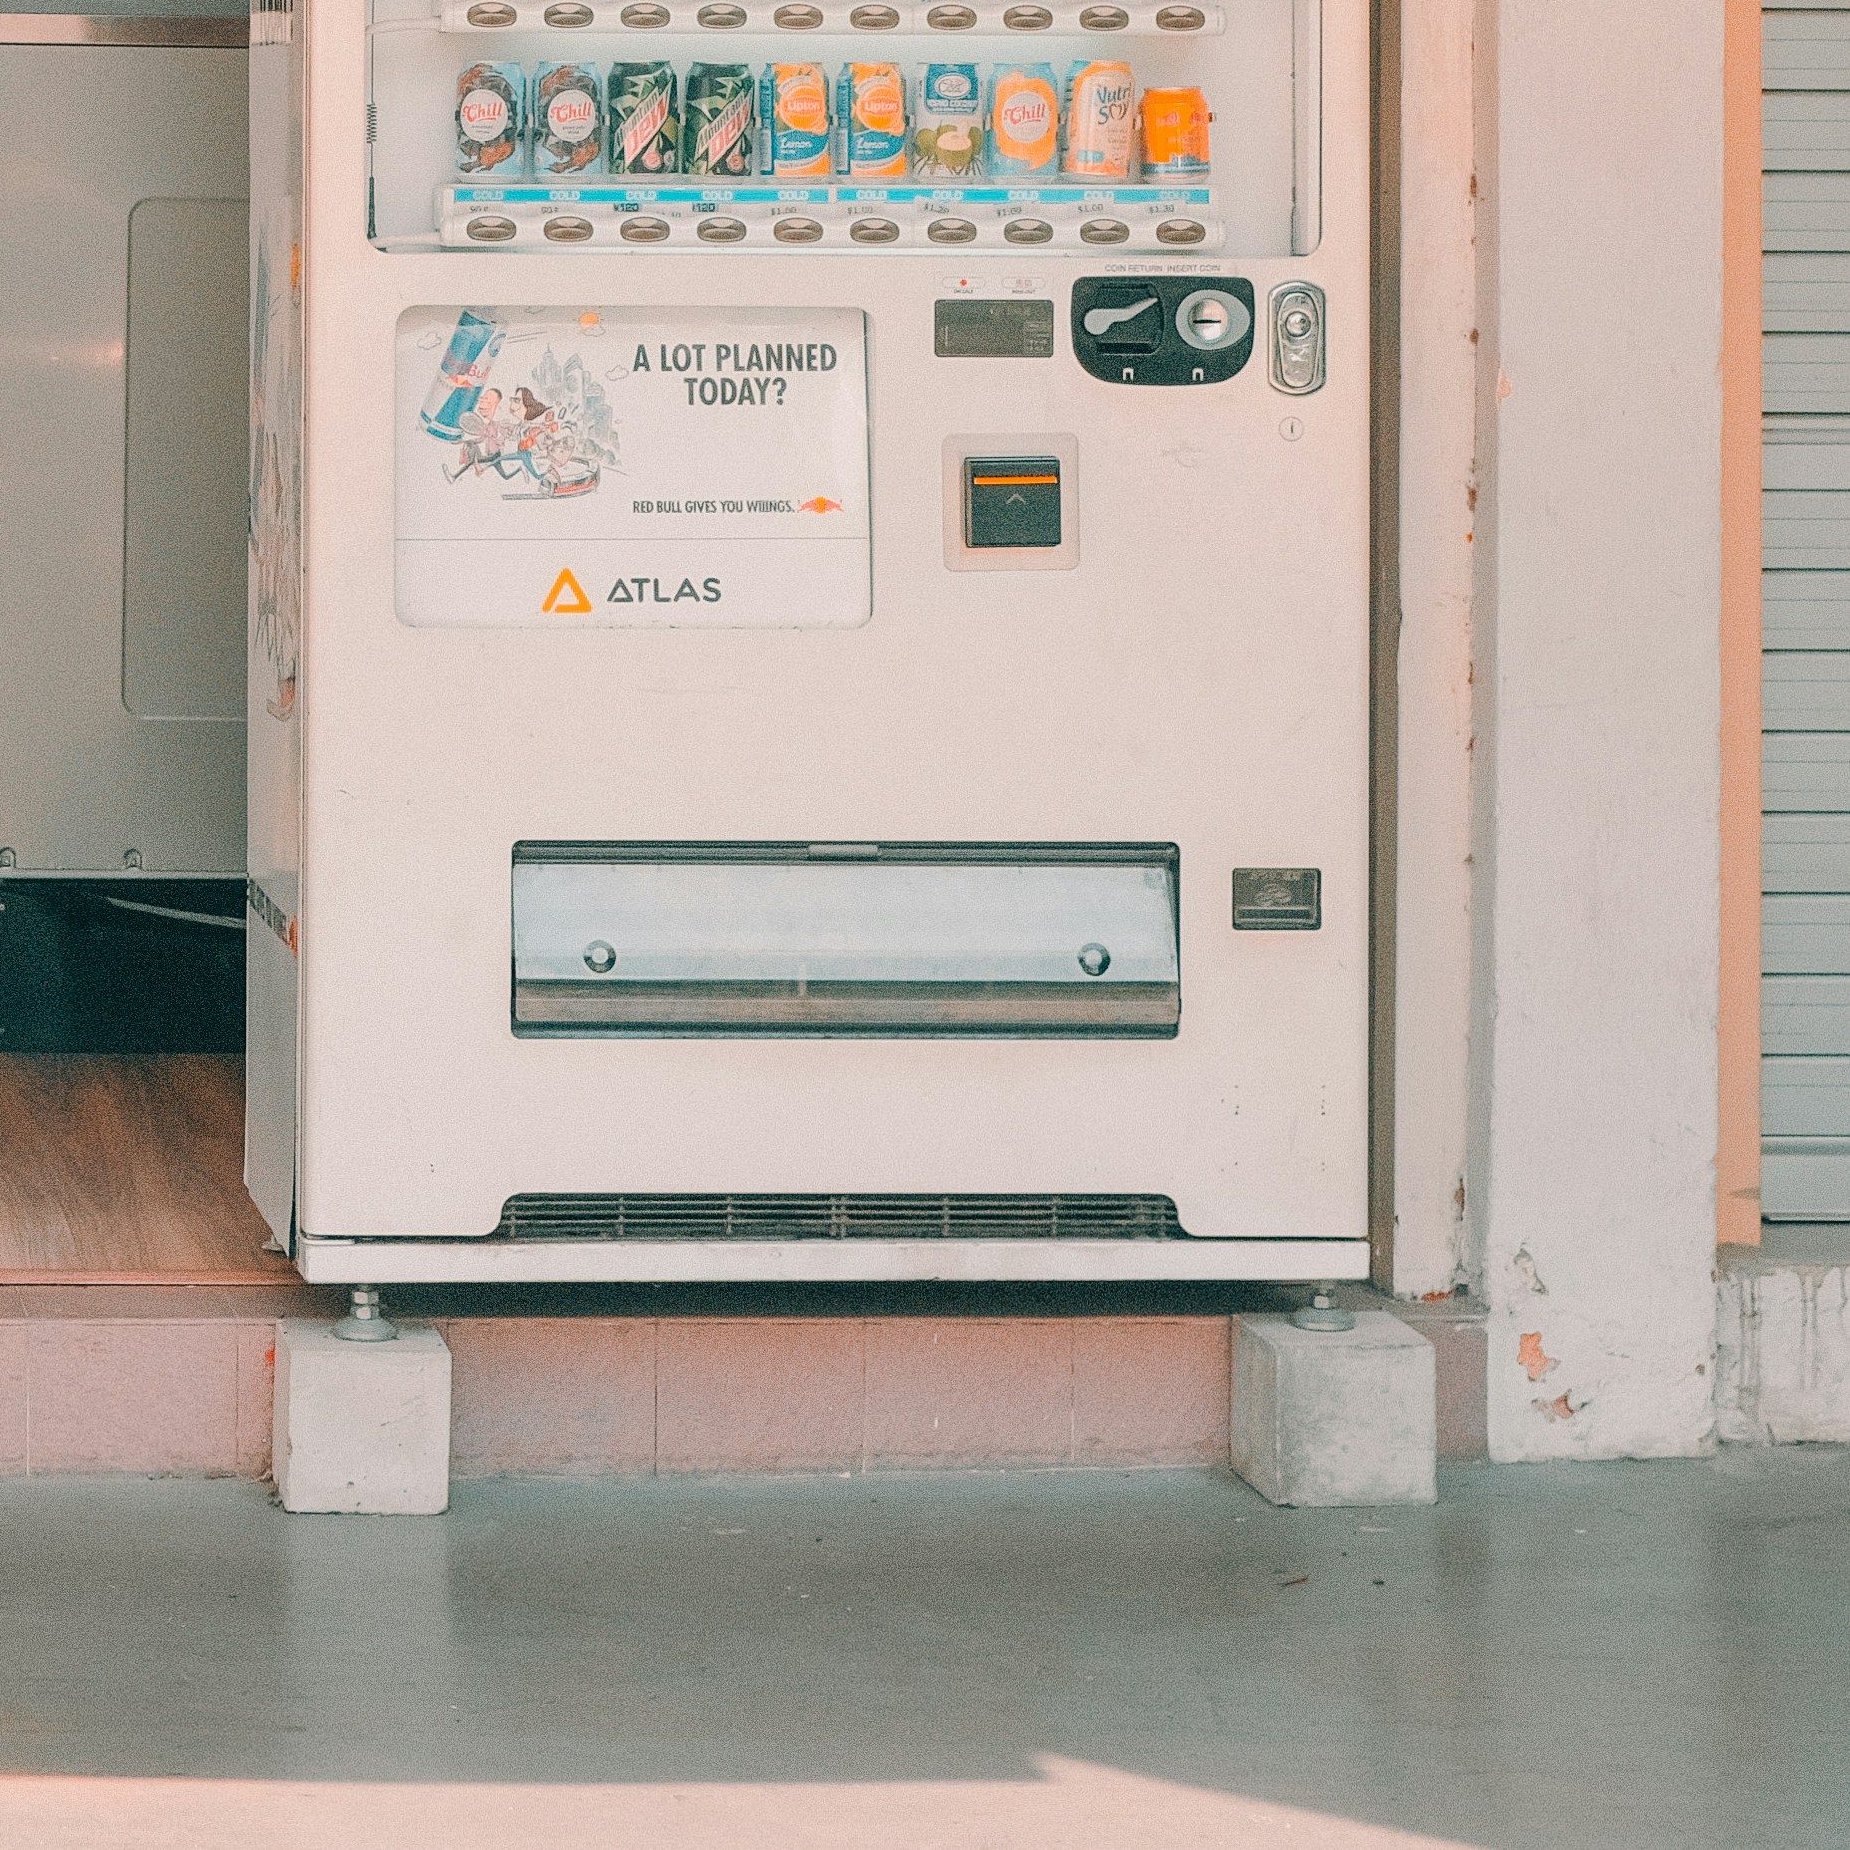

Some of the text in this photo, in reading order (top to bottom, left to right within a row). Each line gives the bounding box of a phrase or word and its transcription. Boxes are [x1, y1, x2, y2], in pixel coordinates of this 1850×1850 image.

[462, 102, 503, 123] Chill
[550, 103, 593, 123] Chill
[787, 101, 821, 113] Lipton
[864, 101, 898, 113] Lipton
[1004, 103, 1046, 125] Chill
[1105, 264, 1127, 272] COIN
[1128, 264, 1163, 272] RETURN
[1167, 264, 1197, 272] INSERT
[633, 344, 837, 372] A LOT PLANNED
[684, 377, 787, 406] TODAY?
[633, 500, 654, 513] RED
[656, 500, 681, 513] BULL
[684, 500, 717, 513] GIVES
[720, 500, 744, 513] YOU
[607, 578, 721, 602] ATLAS
